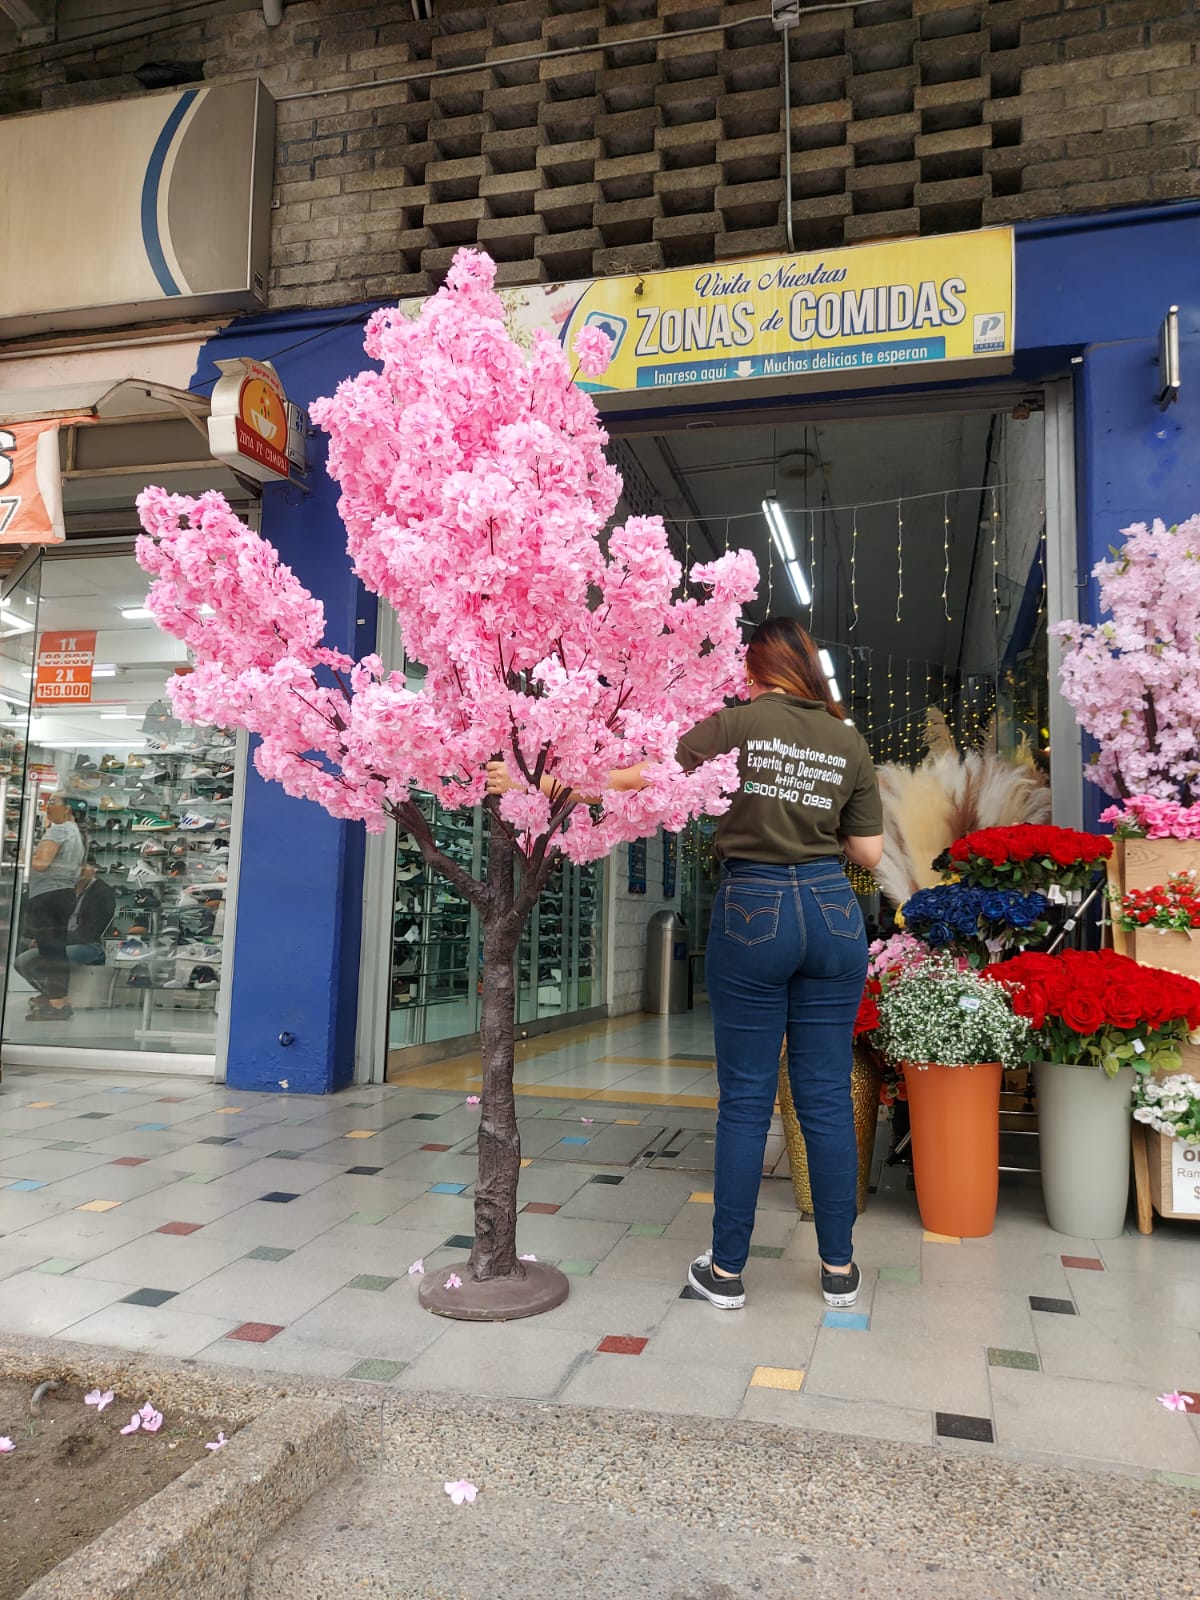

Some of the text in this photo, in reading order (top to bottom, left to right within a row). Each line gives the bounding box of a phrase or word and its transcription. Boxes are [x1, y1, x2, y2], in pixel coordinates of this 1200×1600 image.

[695, 263, 847, 297] Visita Nuestras
[635, 277, 967, 356] ZONAS de COMIDAS
[654, 347, 928, 385] Ingreso aquí Muchas delicias te esperan
[38, 684, 89, 697] 150.000
[747, 737, 847, 768] www.Mapalustore.com
[747, 752, 843, 785] Expertos en Decoracion
[753, 782, 777, 797] 300
[775, 773, 815, 791] Artificial
